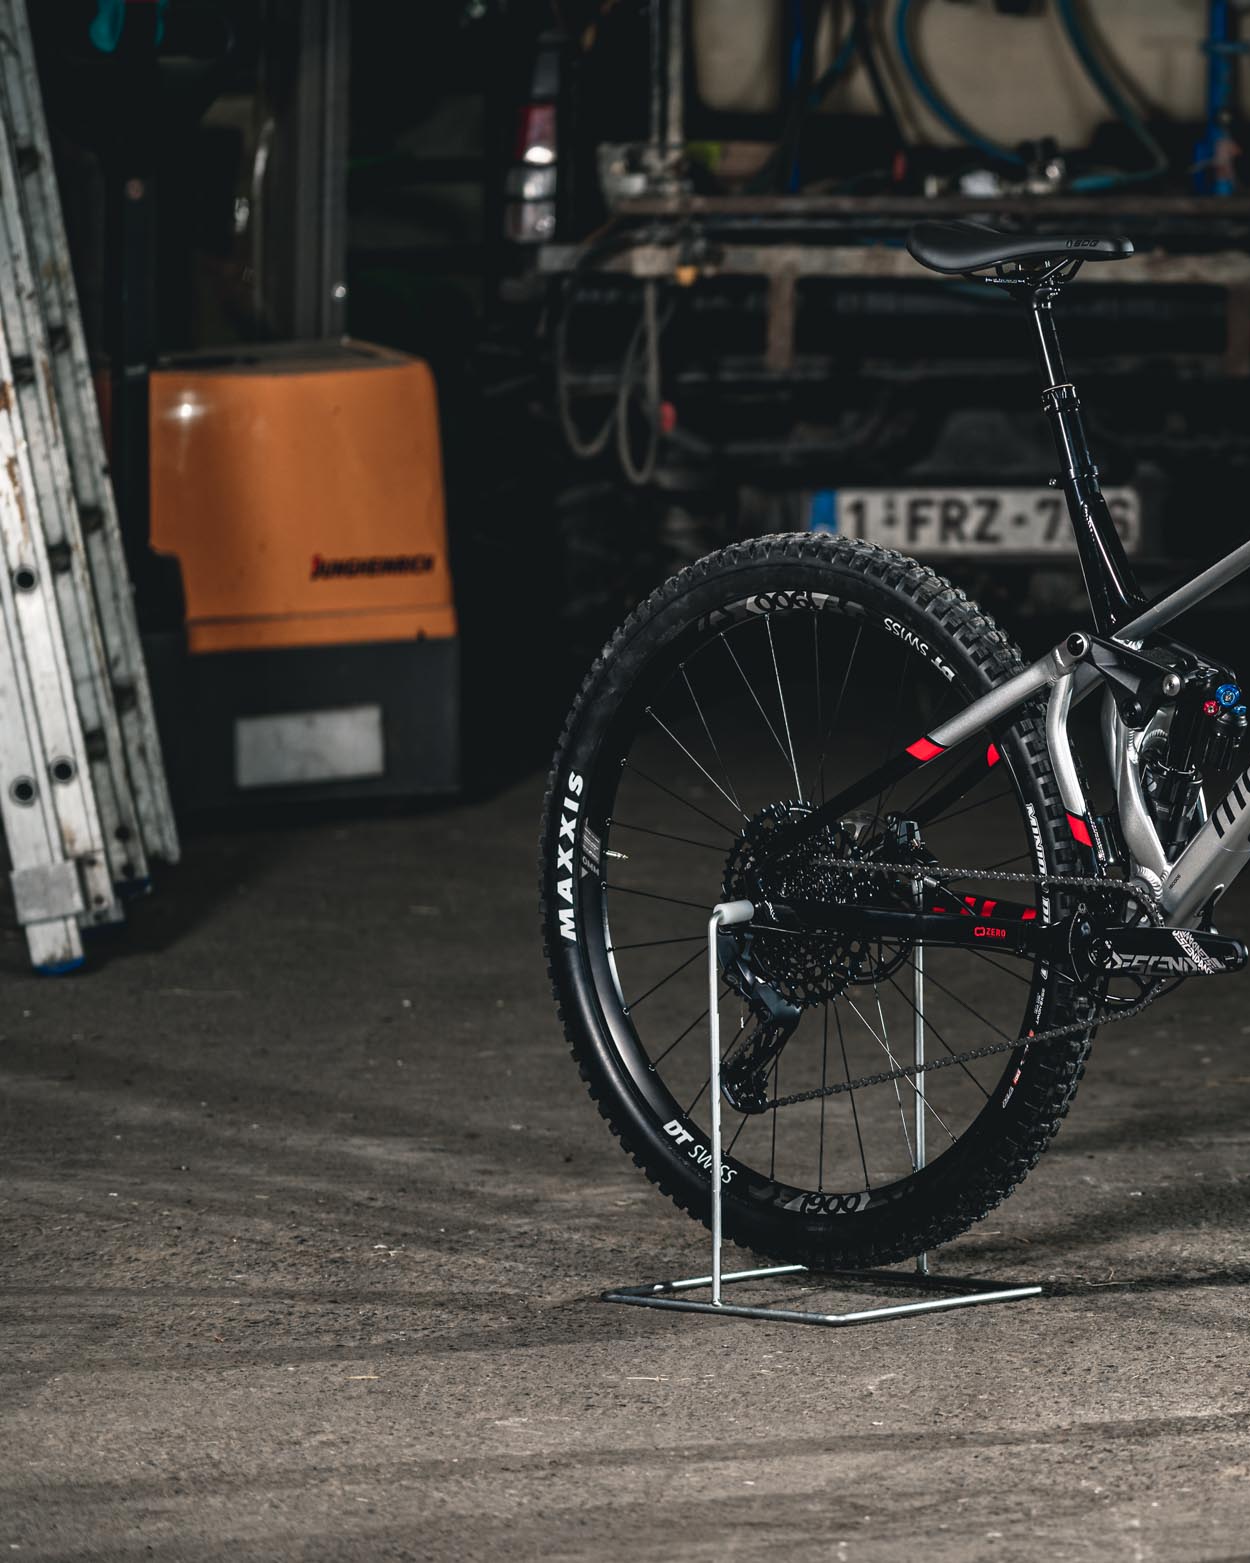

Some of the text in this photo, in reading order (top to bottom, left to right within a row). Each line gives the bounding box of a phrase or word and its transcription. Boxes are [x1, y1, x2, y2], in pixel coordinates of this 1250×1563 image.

[883, 617, 929, 656] SWISS
[556, 771, 584, 942] MAXXIS
[986, 927, 1007, 938] ZERO
[663, 1119, 738, 1184] DT SWSS
